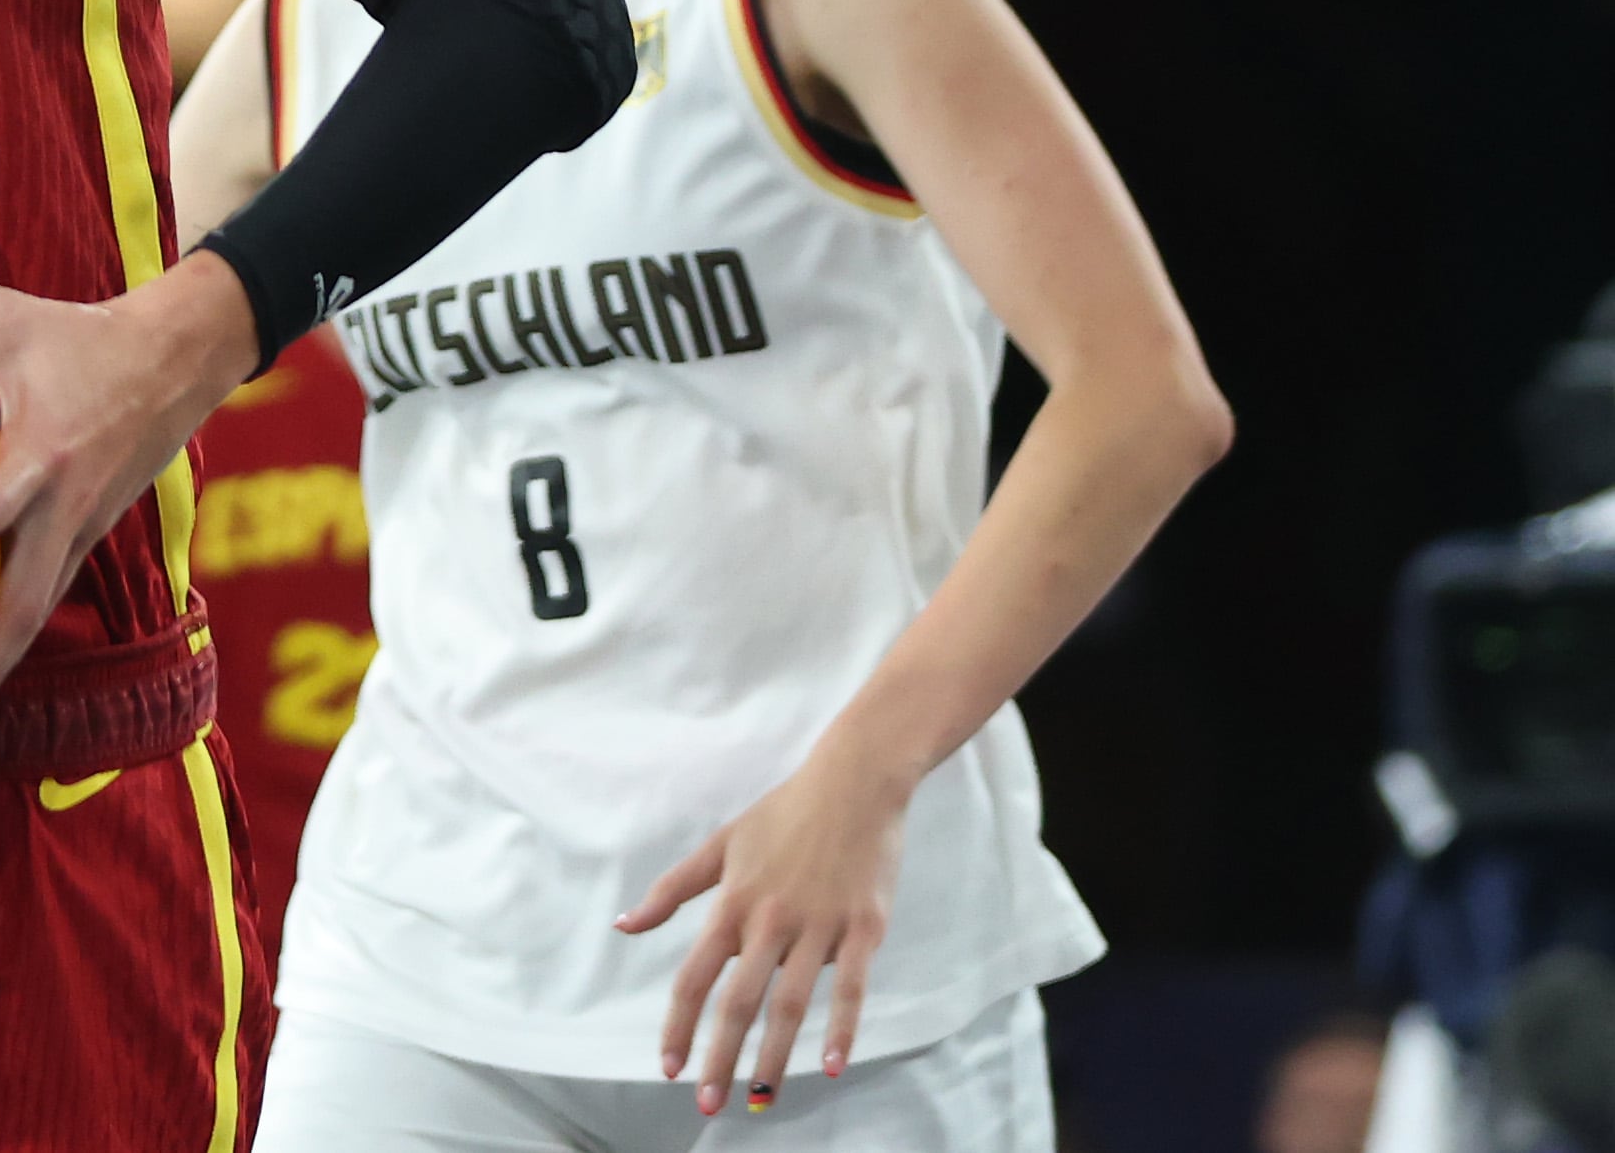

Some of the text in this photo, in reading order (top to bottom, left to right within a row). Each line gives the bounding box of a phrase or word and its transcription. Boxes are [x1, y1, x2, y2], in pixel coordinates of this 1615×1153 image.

[343, 247, 769, 414] UTSCHLAND
[510, 454, 589, 621] 8
[265, 620, 380, 747] 2
